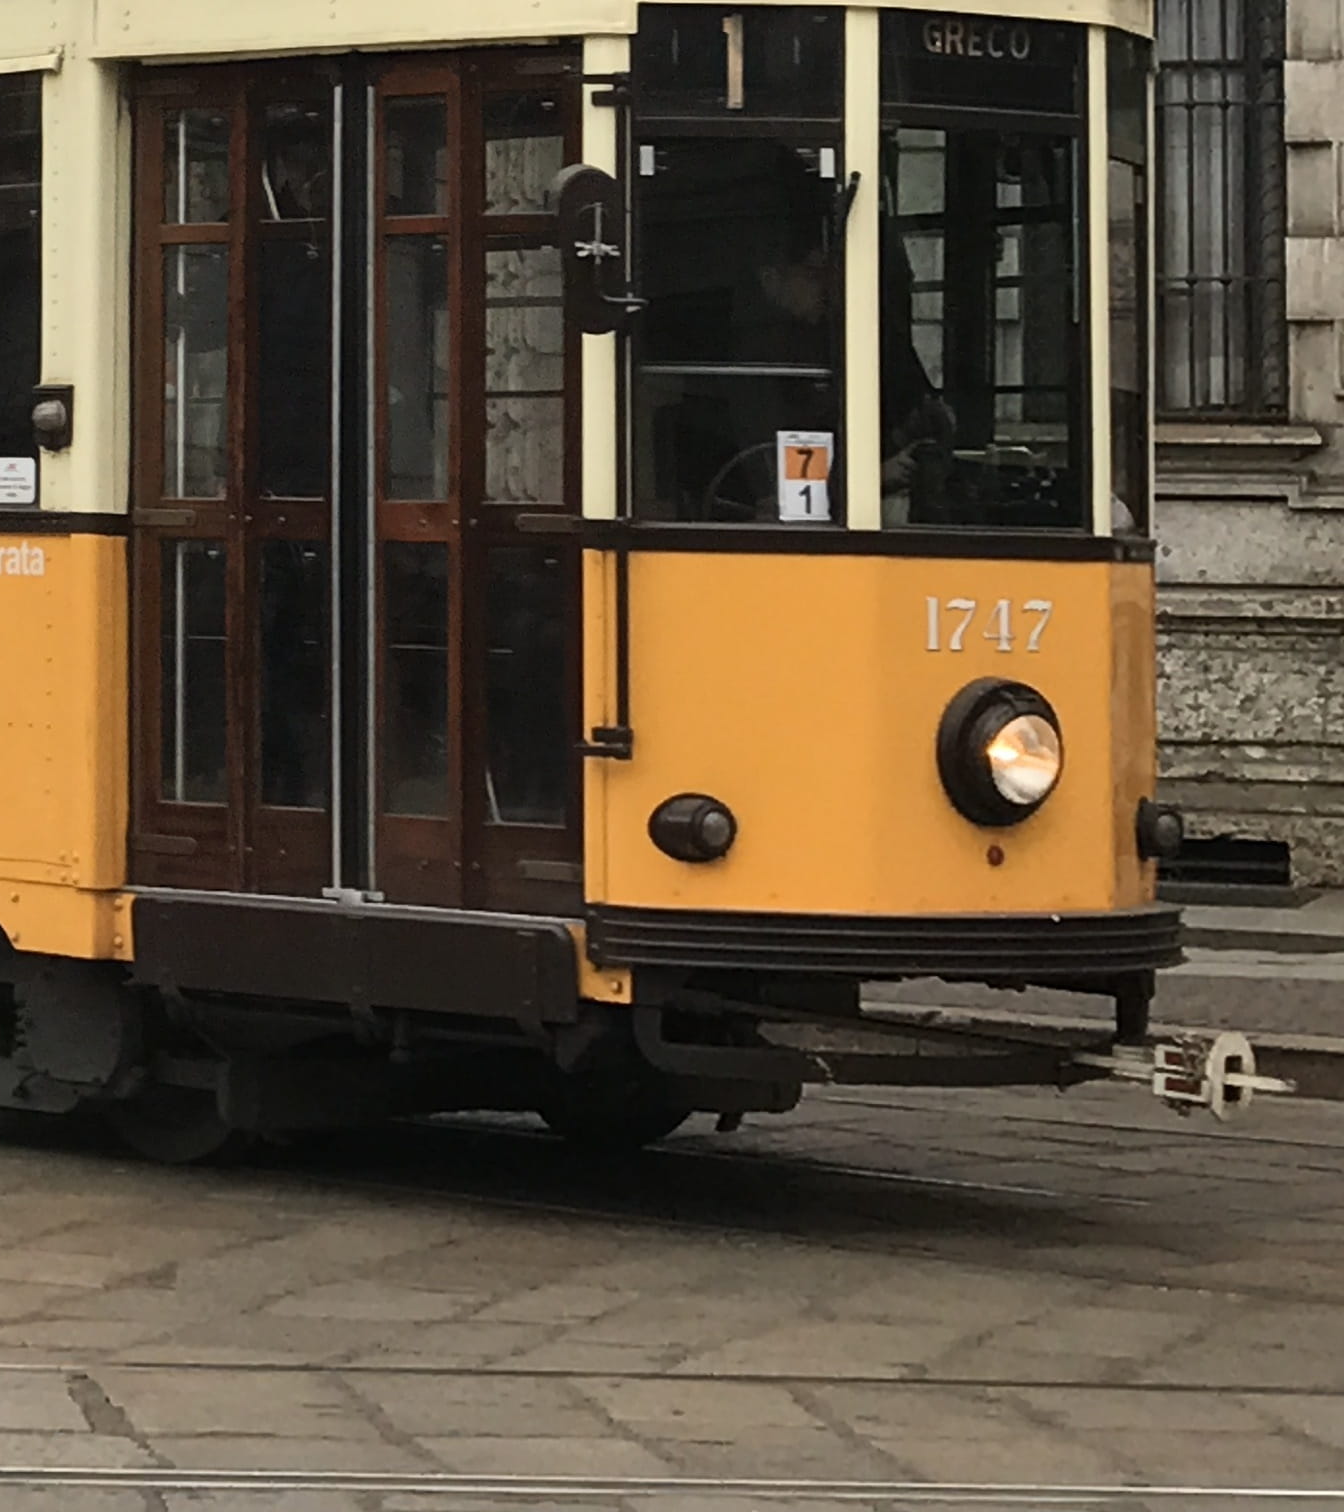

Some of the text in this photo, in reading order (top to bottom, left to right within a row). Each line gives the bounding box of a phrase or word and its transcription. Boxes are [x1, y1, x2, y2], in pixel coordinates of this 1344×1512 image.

[924, 20, 1030, 59] GRECO
[722, 13, 744, 109] 1
[796, 449, 815, 479] 7
[798, 484, 812, 515] 1
[924, 596, 1054, 653] 1747
